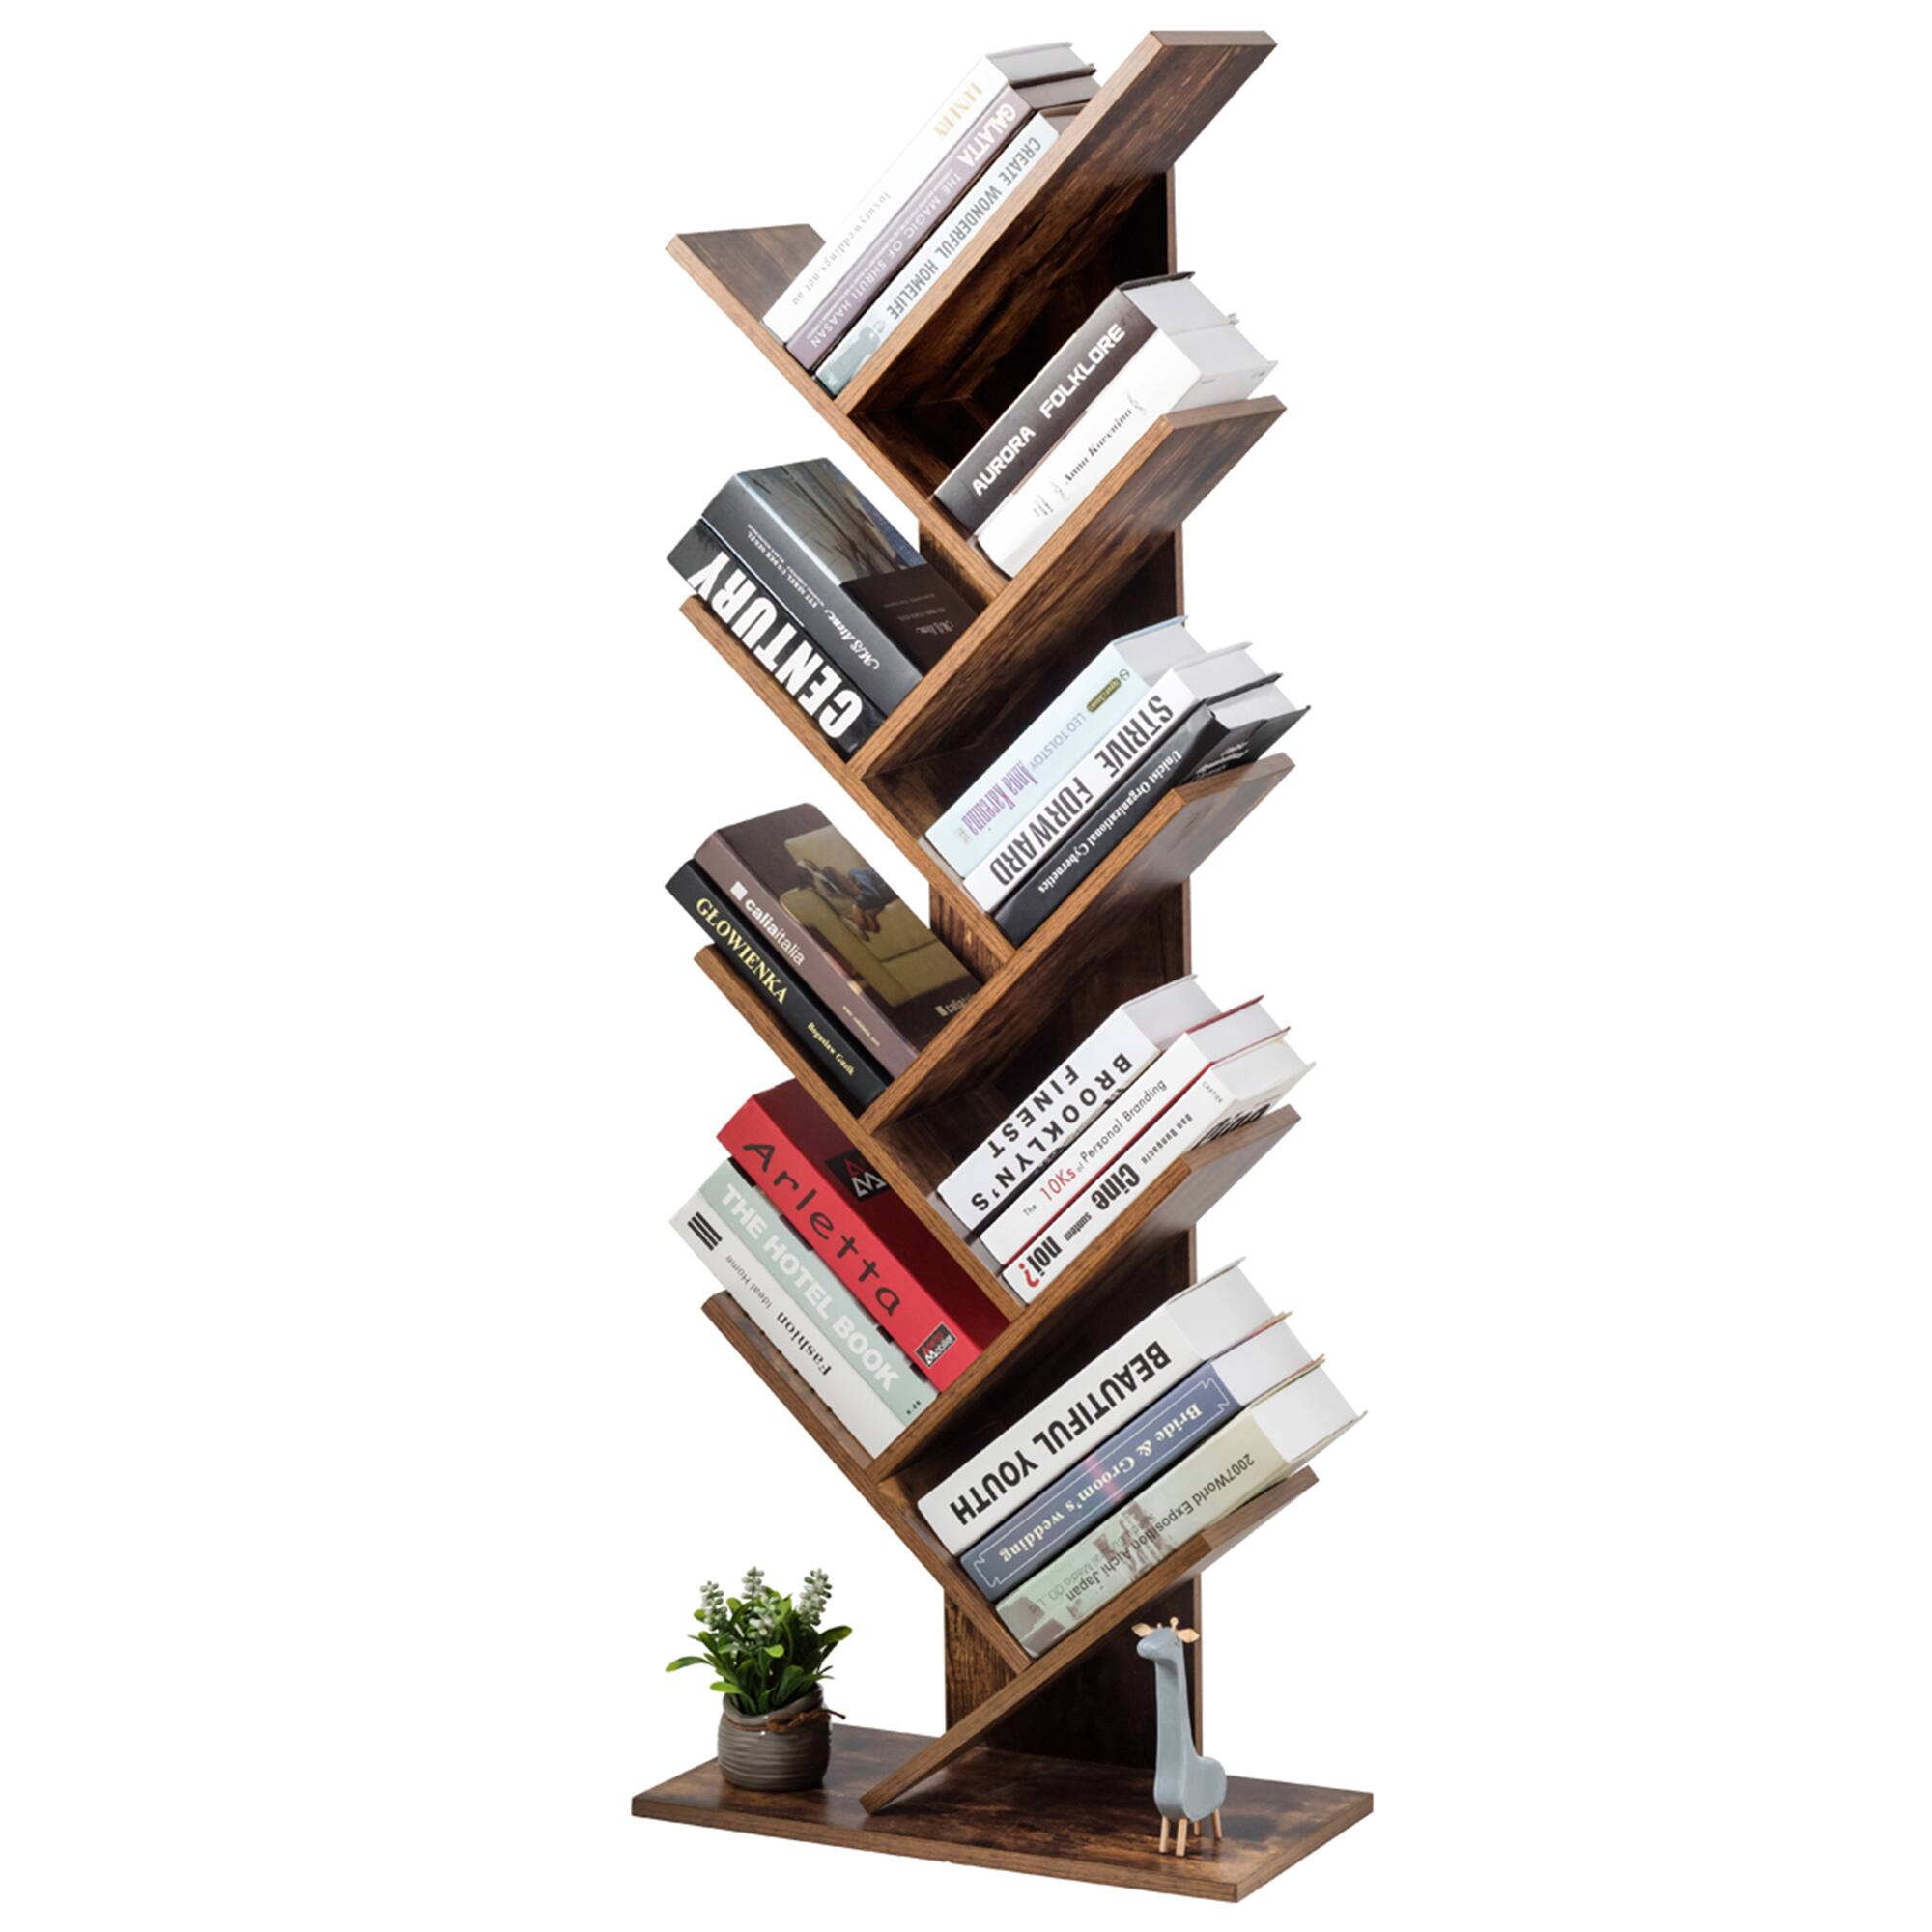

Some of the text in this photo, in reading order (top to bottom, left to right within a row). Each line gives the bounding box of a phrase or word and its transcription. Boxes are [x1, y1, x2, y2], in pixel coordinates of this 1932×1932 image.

[934, 83, 982, 136] LUXURY
[957, 103, 1015, 166] GALATTA
[811, 172, 962, 347] THE MAGIC OF SHRUTI HAASAN
[887, 137, 1041, 320] CREATE WONDERFUL HOMELIFE
[973, 426, 1036, 496] AURORA
[1039, 324, 1124, 419] FOLKLORE
[1065, 410, 1132, 481] Anna Karenina
[688, 552, 863, 738] CENTURY
[1030, 713, 1087, 770] LEO TOLSTOY
[1094, 696, 1173, 778] STRIVE
[1149, 750, 1181, 783] Unicist
[961, 761, 1037, 835] Anna Karenina
[990, 778, 1094, 885] FORWARD
[1087, 781, 1151, 846] Organizational
[1038, 843, 1089, 893] Cybernetics
[745, 899, 804, 964] caliaitalia
[972, 1054, 1132, 1210] BROOKLYN'S
[988, 1065, 1078, 1157] FINEST
[1023, 1204, 1037, 1217] The
[1040, 1169, 1076, 1200] 10Ks
[1080, 1119, 1122, 1162] Personal
[1122, 1080, 1167, 1122] Branding
[1092, 1164, 1140, 1209] Cine
[742, 1144, 900, 1315] Arletta
[1019, 1236, 1062, 1287] noi?
[1064, 1212, 1092, 1241] suntem
[723, 1183, 899, 1391] THE HOTEL BOOK
[726, 1256, 831, 1375] Fashion Ideal Home
[950, 1341, 1171, 1525] BEAUTIFUL YOUTH
[1000, 1404, 1202, 1561] Bride & Groom's wedding
[1101, 1545, 1134, 1577] Aichi
[1128, 1501, 1194, 1554] Exposition
[1066, 1568, 1100, 1604] Japan
